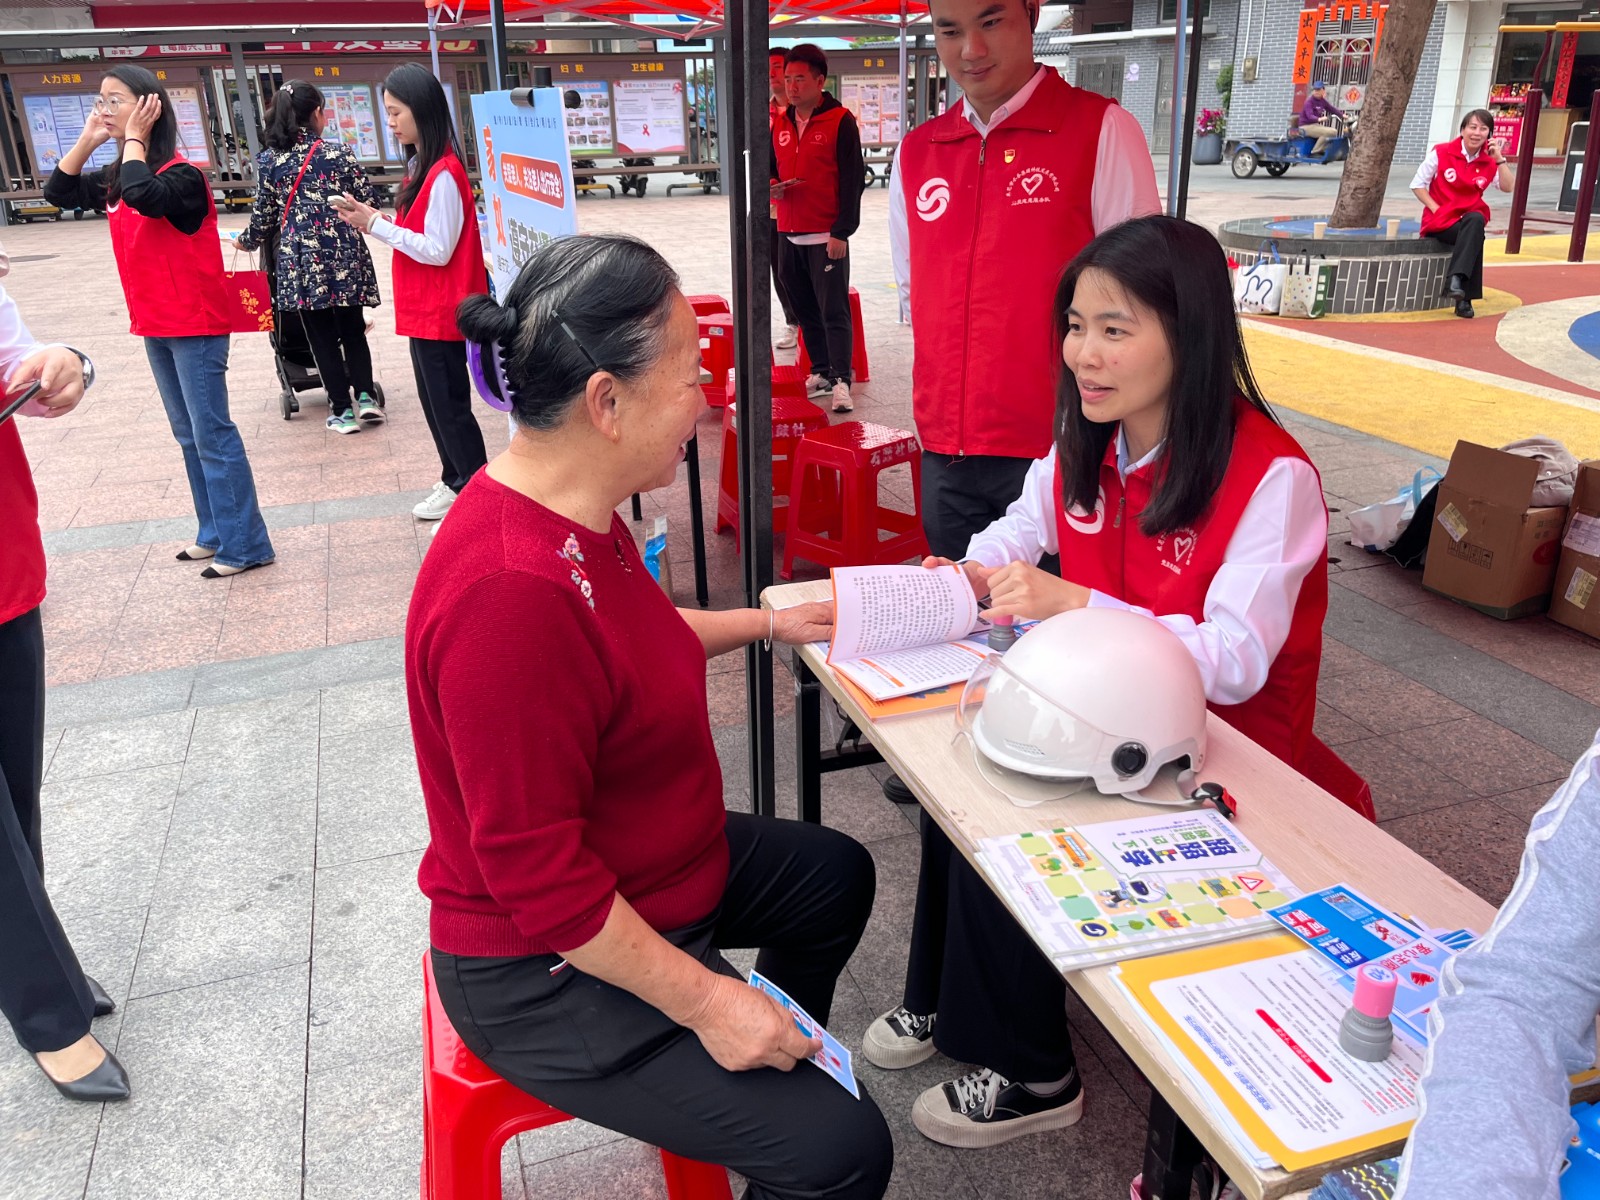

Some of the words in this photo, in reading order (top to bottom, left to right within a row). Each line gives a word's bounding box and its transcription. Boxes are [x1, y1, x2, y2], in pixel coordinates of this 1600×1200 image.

[1295, 13, 1313, 79] 出入平安
[314, 66, 340, 77] 教育
[560, 63, 585, 74] 妇联
[631, 62, 665, 73] 卫生健康
[41, 73, 83, 85] 人力资源
[156, 70, 167, 81] 保
[1294, 919, 1327, 937] 问卷
[1340, 950, 1362, 965] 反诈
